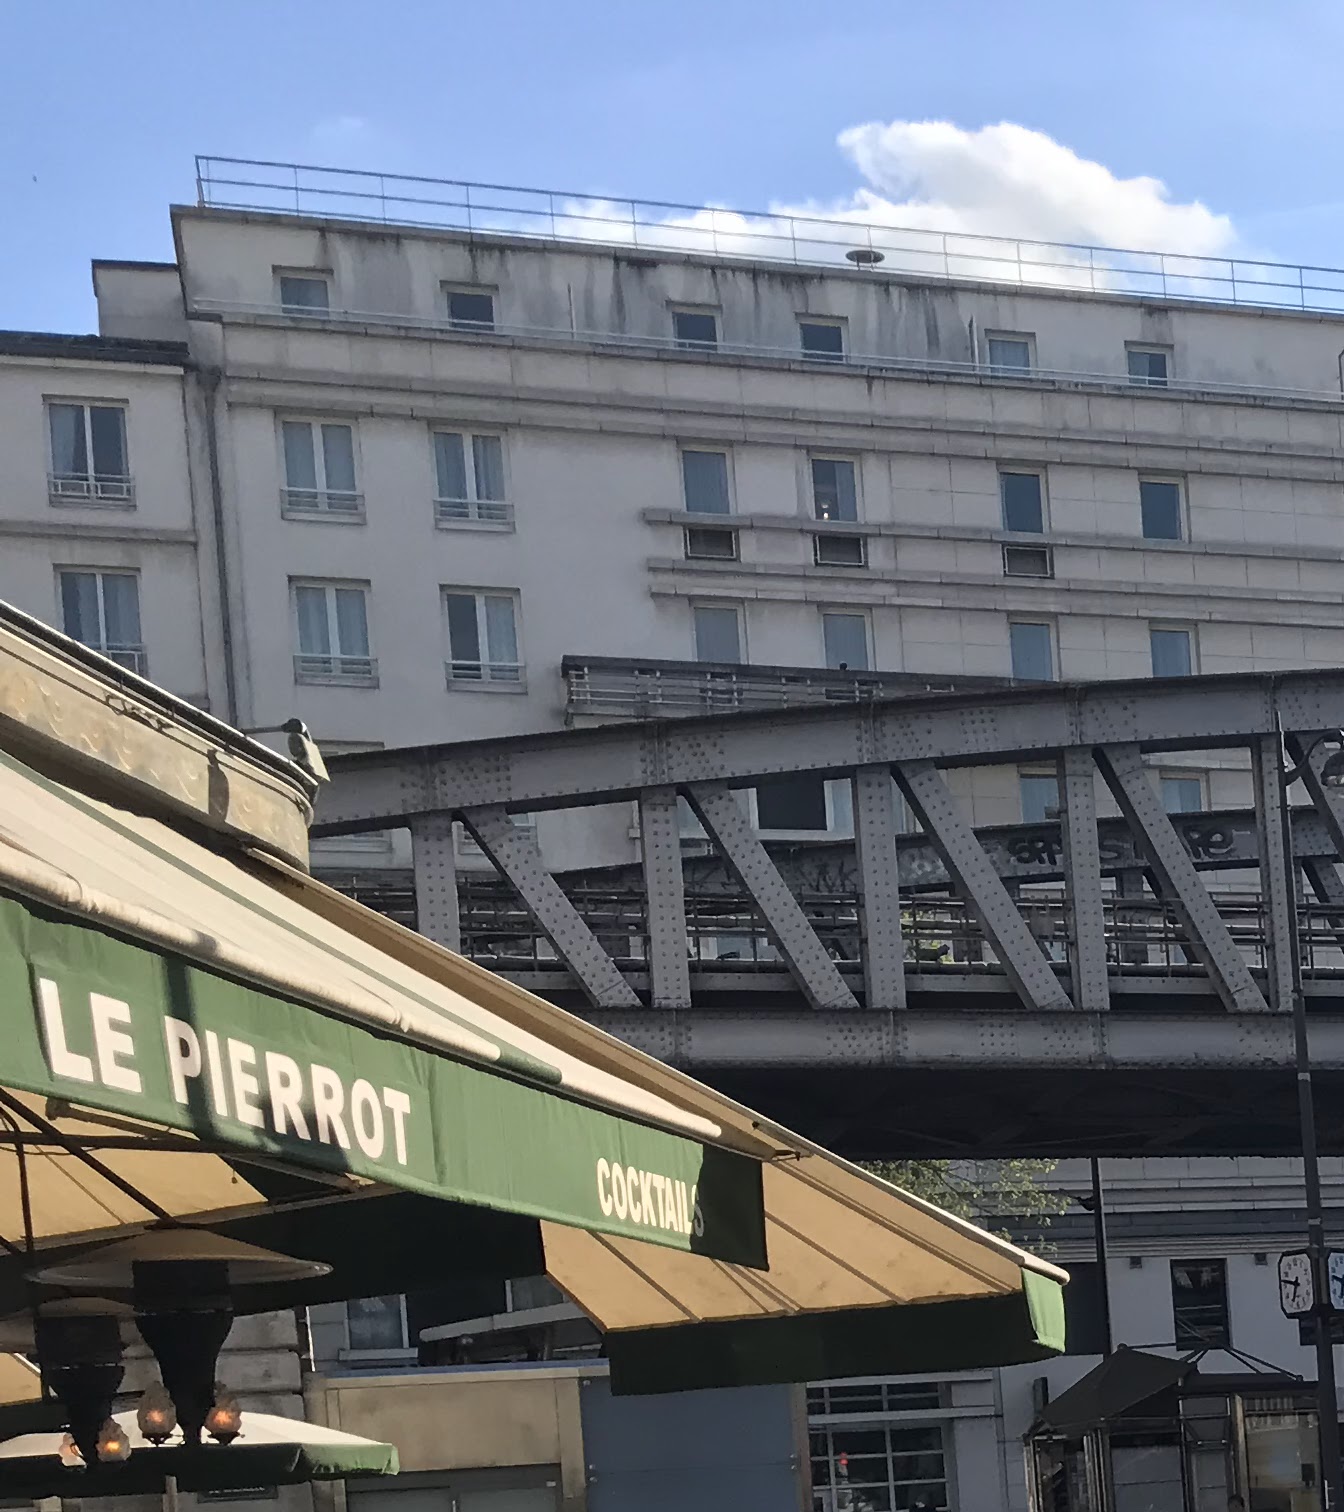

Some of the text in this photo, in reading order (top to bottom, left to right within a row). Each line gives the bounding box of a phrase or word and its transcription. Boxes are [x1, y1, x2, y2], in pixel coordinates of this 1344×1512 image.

[39, 977, 411, 1167] LE PIERROT
[596, 1157, 705, 1238] COCKTAILS
